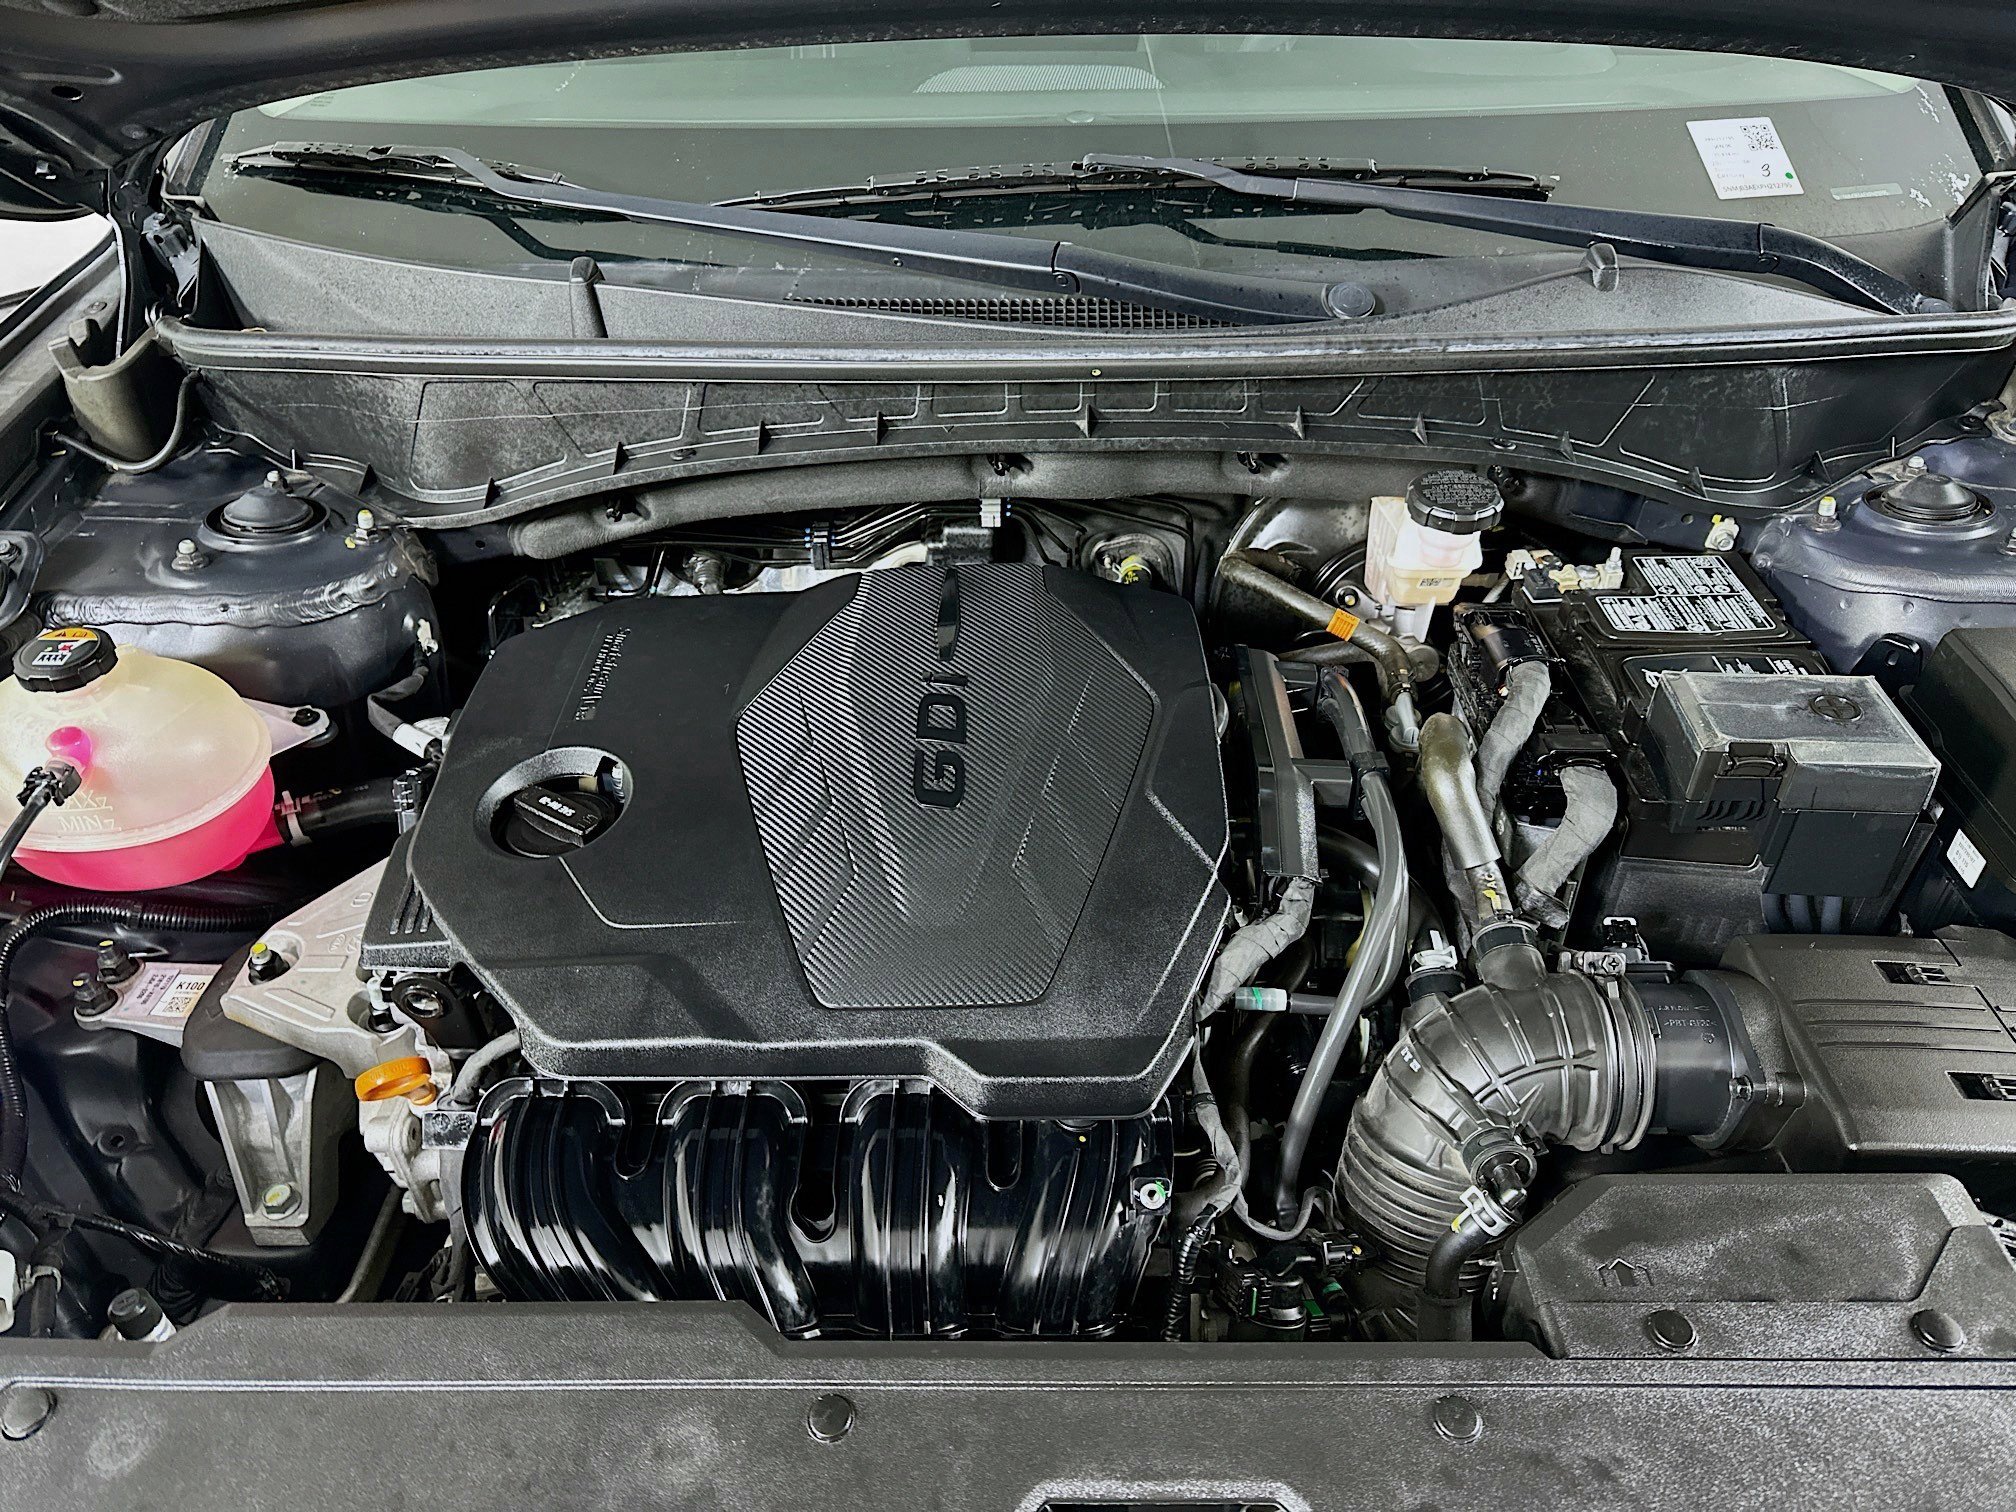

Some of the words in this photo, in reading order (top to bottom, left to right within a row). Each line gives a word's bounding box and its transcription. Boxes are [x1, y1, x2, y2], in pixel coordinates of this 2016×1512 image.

[1761, 163, 1771, 178] 3
[58, 814, 103, 832] MIN
[176, 981, 206, 991] K100
